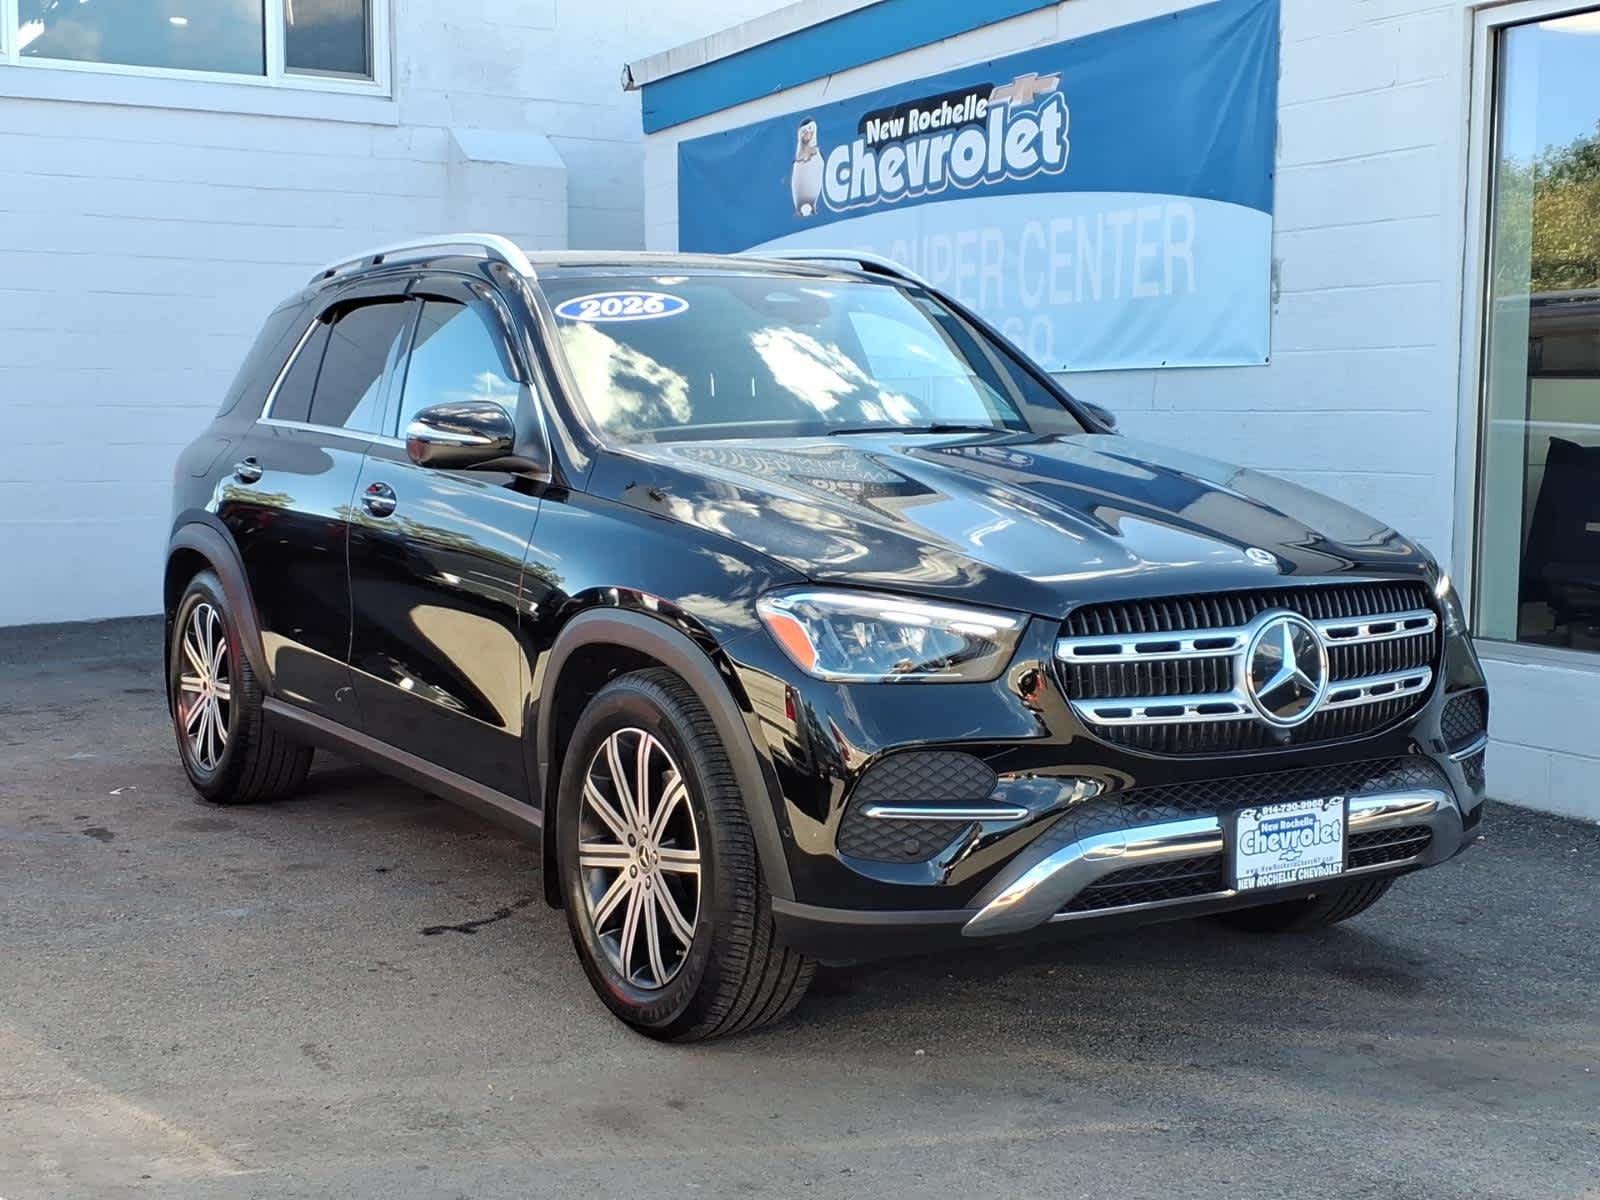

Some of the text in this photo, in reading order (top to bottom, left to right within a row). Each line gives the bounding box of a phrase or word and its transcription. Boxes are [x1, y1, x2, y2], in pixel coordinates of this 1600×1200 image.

[865, 94, 988, 145] New Rochelle
[825, 100, 1062, 202] Chevrolet
[1018, 202, 1196, 309] CENTER
[580, 296, 665, 318] 2026
[1240, 818, 1341, 856] Chevrolet
[1261, 816, 1314, 833] New Rochelle
[1238, 877, 1255, 890] NEW
[1257, 868, 1297, 887] ROCHELLE
[1298, 863, 1343, 880] CHEVROLET
